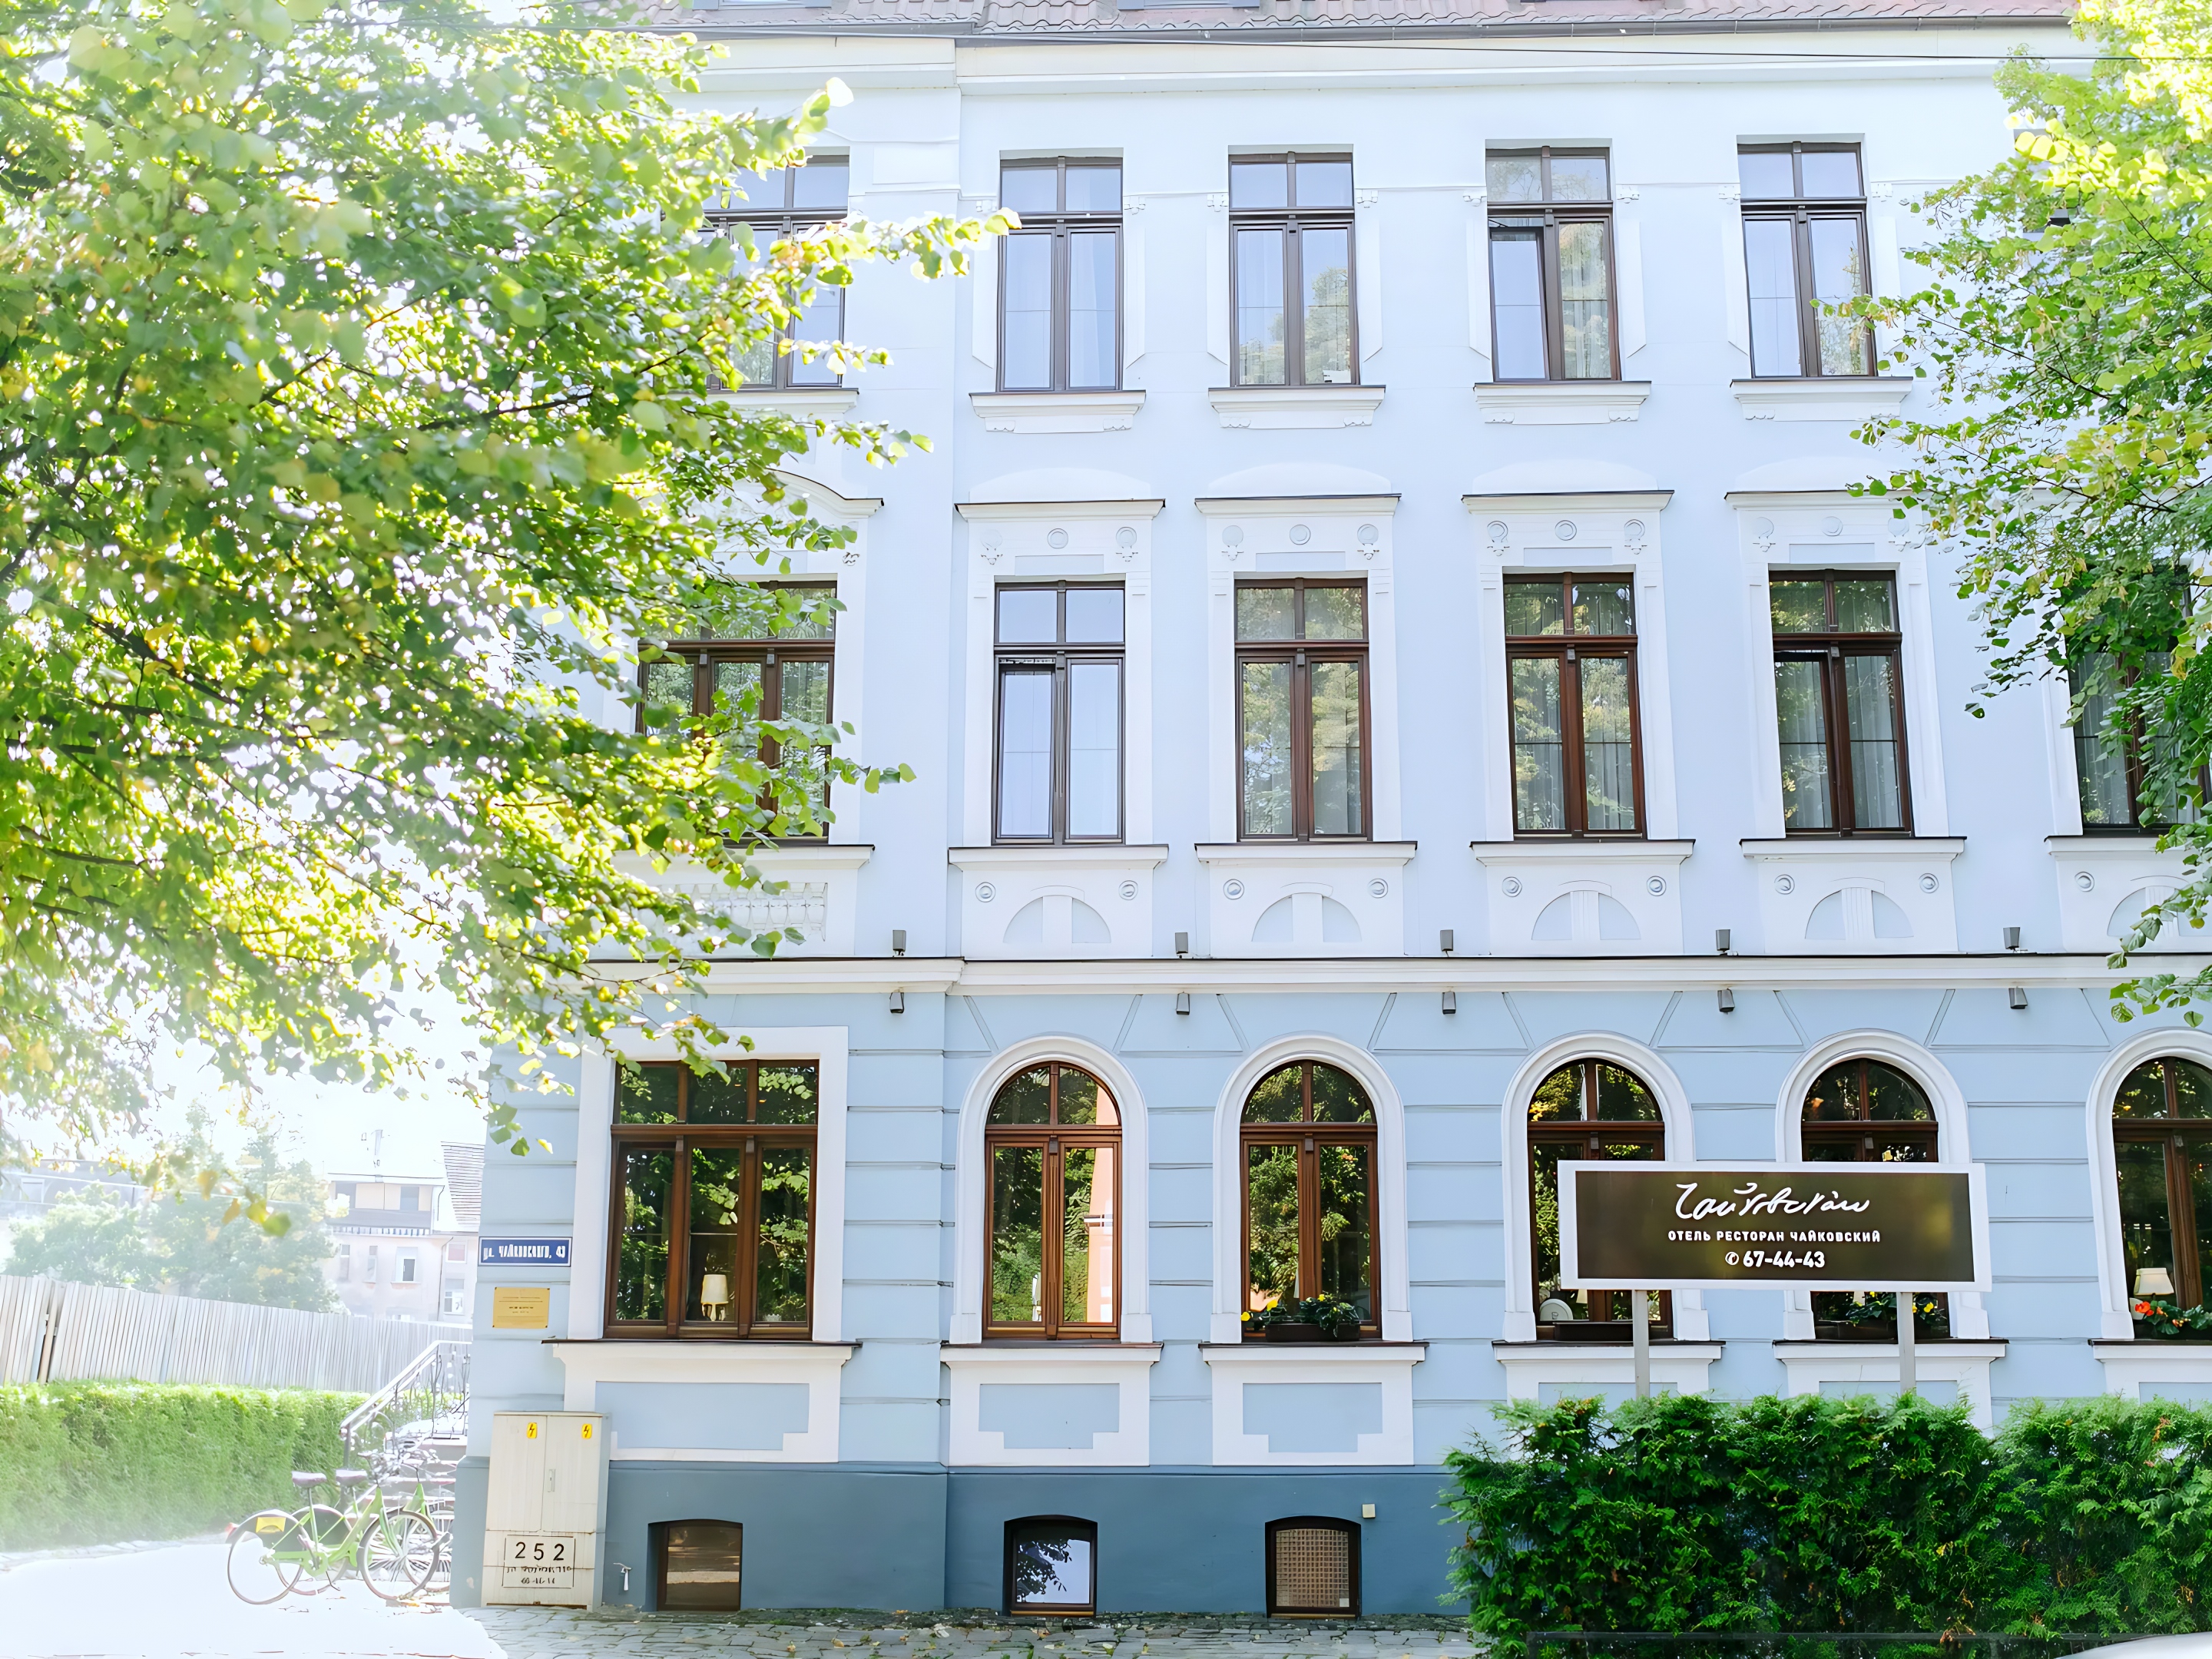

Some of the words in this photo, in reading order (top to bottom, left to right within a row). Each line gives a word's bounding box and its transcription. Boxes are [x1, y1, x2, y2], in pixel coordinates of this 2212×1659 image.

[1667, 1230, 1711, 1241] ОТЕЛЬ
[1716, 1230, 1784, 1242] РЕСТОРАН
[1790, 1230, 1880, 1243] ЧАЙКОВСКИЙ
[1743, 1250, 1826, 1268] 67-44-43
[515, 1541, 565, 1561] 252
